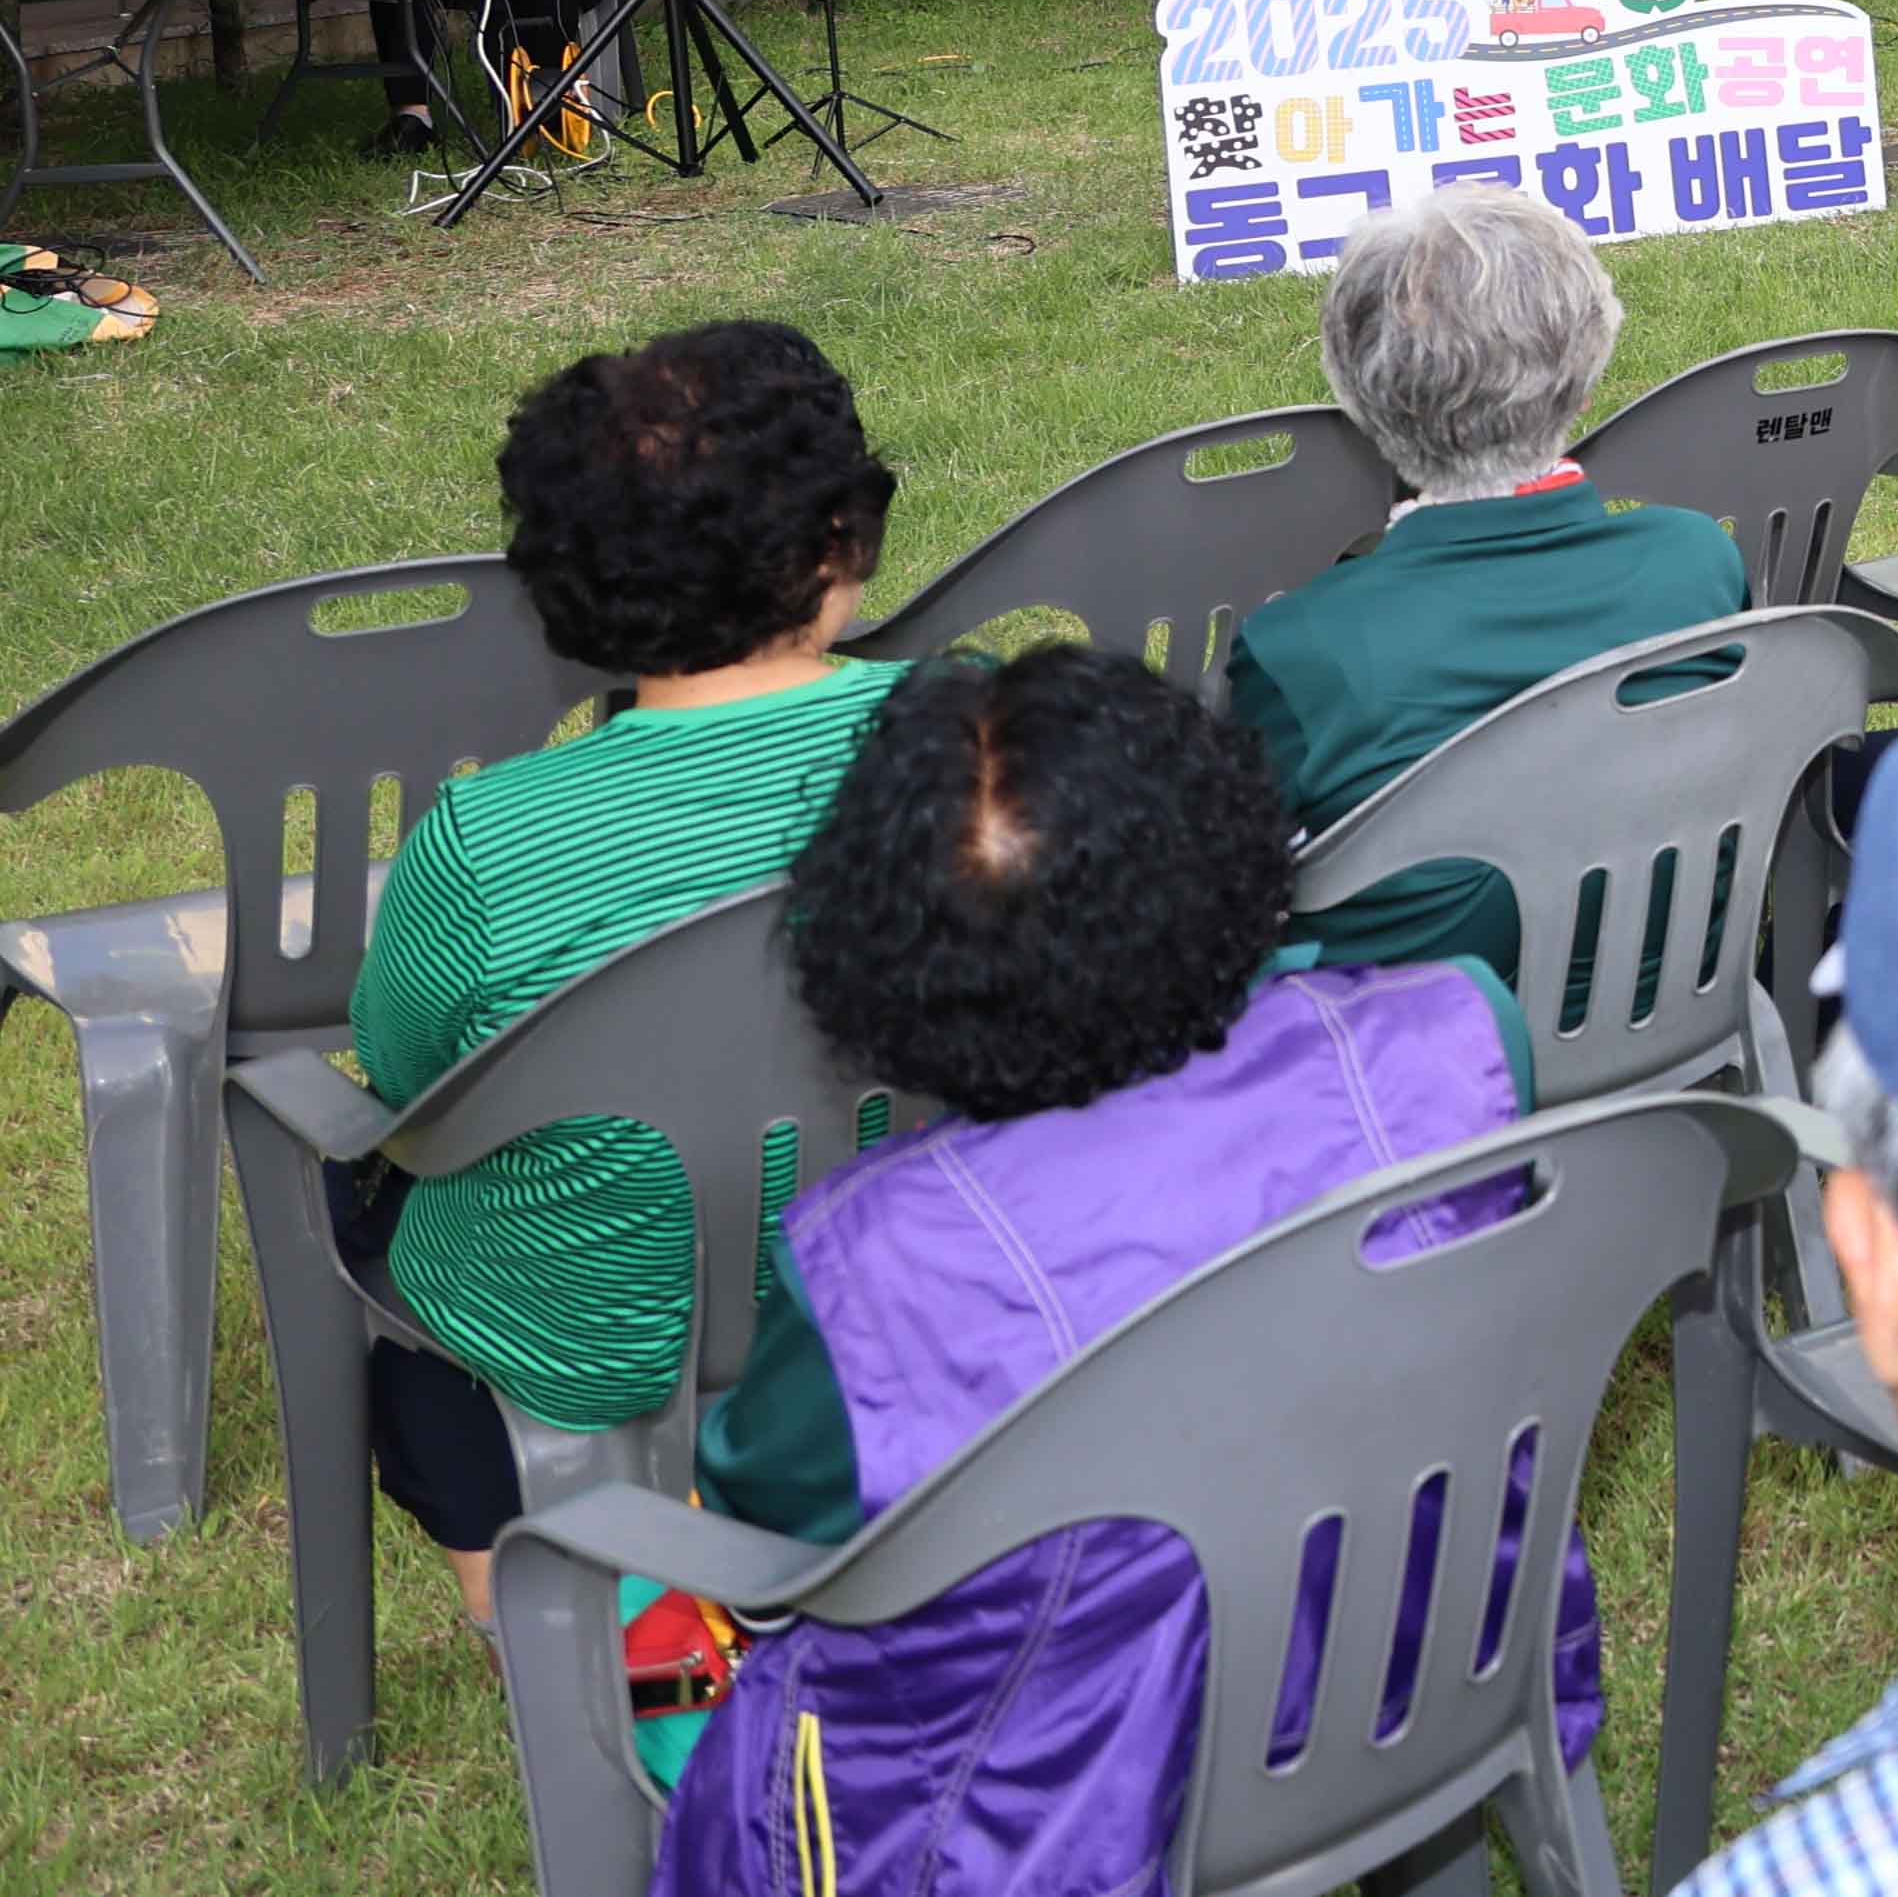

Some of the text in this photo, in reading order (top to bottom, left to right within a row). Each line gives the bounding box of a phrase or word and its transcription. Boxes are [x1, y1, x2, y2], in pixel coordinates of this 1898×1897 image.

[1173, 35, 1866, 180] 찾아가는 문화공연
[1669, 115, 1873, 223] 배달
[1756, 406, 1833, 445] 렌탈맨
